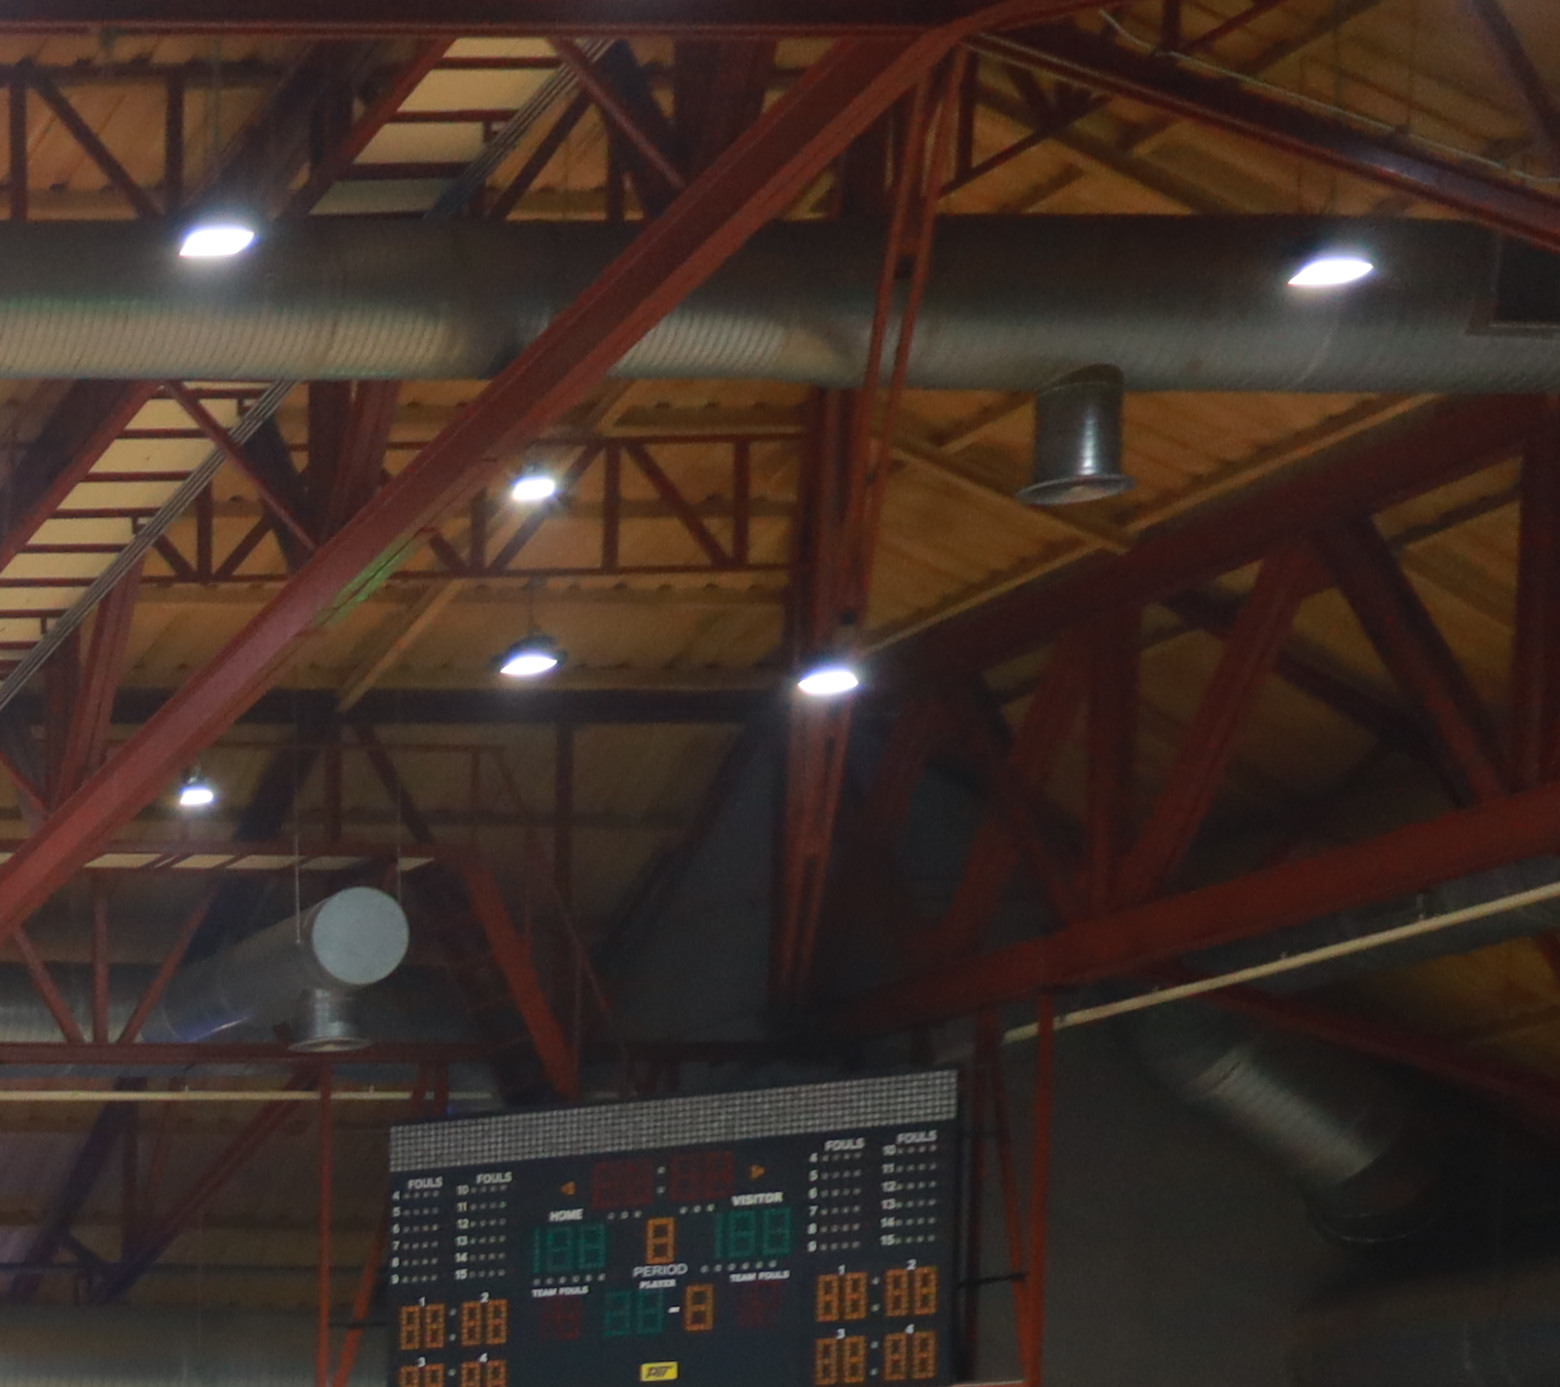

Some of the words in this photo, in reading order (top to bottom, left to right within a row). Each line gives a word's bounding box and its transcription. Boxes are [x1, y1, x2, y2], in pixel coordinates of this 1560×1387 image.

[824, 1137, 865, 1151] FOULS
[896, 1130, 938, 1144] FOULS
[408, 1176, 443, 1190] FOULS
[476, 1172, 512, 1184] FOULS
[731, 1192, 784, 1206] VISITOR
[549, 1208, 584, 1222] HOME
[632, 1264, 688, 1277] PERIOD
[730, 1272, 756, 1282] TEAM
[758, 1270, 790, 1280] FOULS
[532, 1287, 556, 1298] TEAM
[558, 1285, 589, 1295] FOULS
